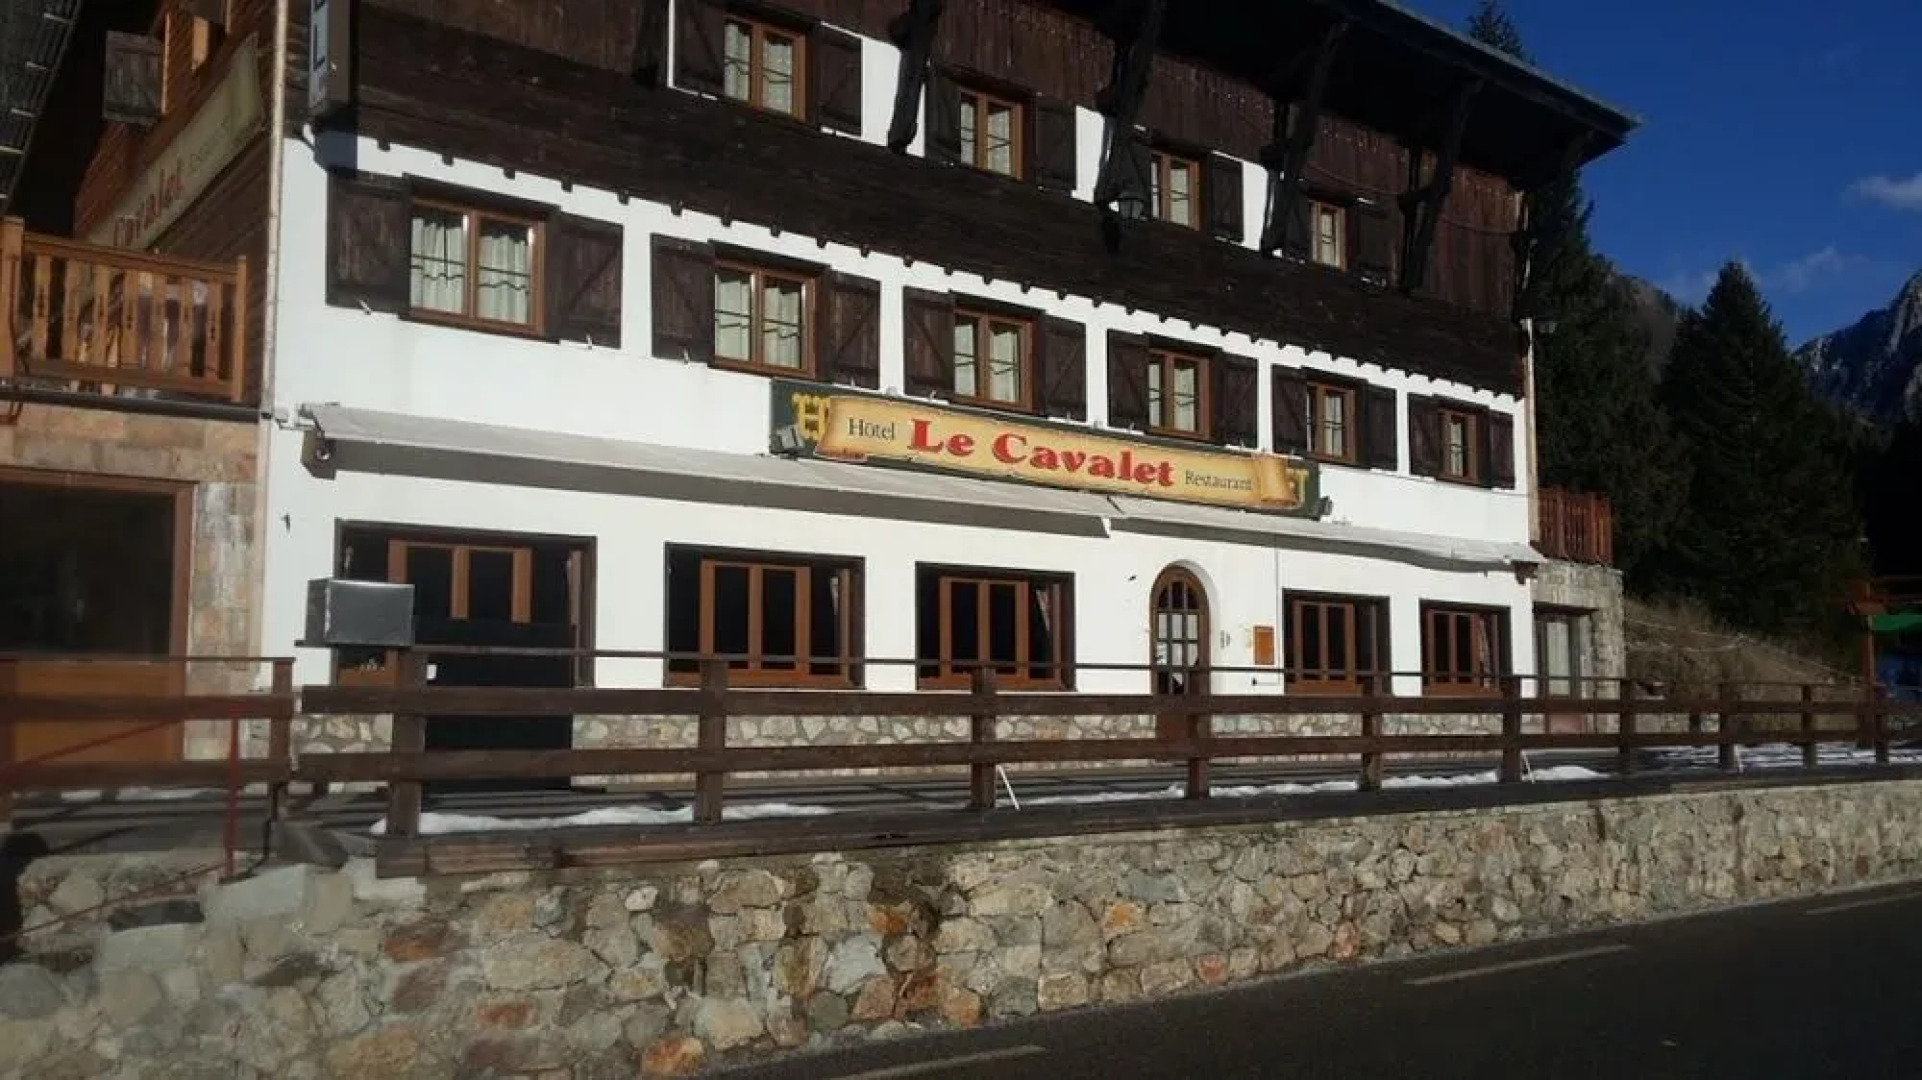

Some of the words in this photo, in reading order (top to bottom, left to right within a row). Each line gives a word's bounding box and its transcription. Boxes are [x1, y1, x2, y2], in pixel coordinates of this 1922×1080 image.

[908, 418, 975, 457] Le
[991, 433, 1176, 487] Cavalet
[1185, 469, 1253, 491] Restaurant
